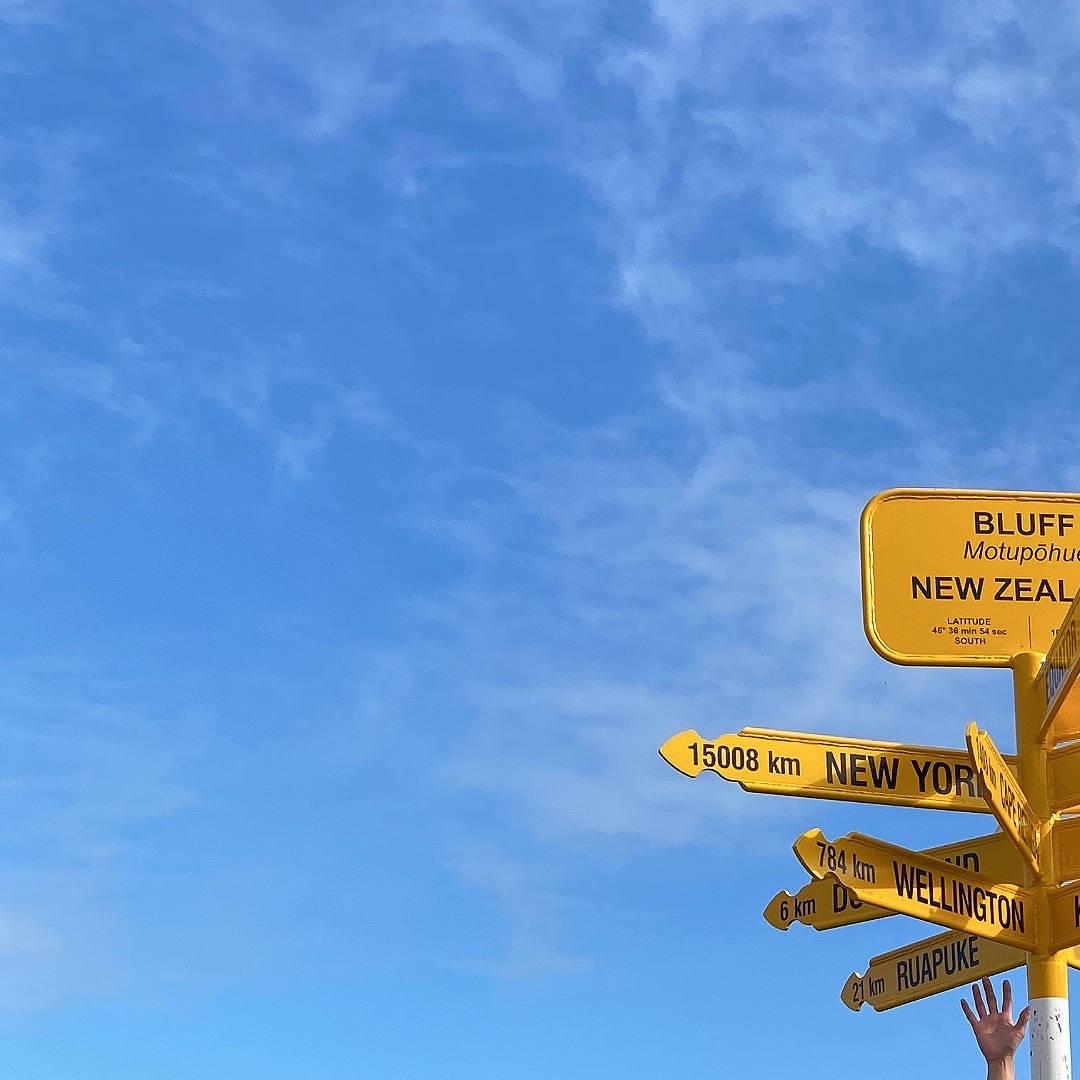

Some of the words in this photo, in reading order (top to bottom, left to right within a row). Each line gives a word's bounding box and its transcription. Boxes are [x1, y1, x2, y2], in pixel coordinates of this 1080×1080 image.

[974, 511, 1075, 537] BLUFF
[911, 575, 985, 601] NEW
[947, 617, 991, 626] LATITUDE
[961, 627, 977, 635] min
[979, 627, 990, 635] 54
[954, 637, 986, 645] SOUTH
[687, 742, 759, 772] 15008
[768, 750, 801, 776] km
[825, 751, 900, 790] NEW
[911, 759, 984, 798] YOR
[816, 842, 847, 875] 784
[853, 853, 876, 885] km
[891, 859, 1025, 934] WELLINGTON
[779, 900, 790, 922] 6
[794, 896, 817, 919] km
[852, 983, 865, 1003] 21
[868, 976, 886, 997] km
[896, 936, 980, 992] RUAPUKE
